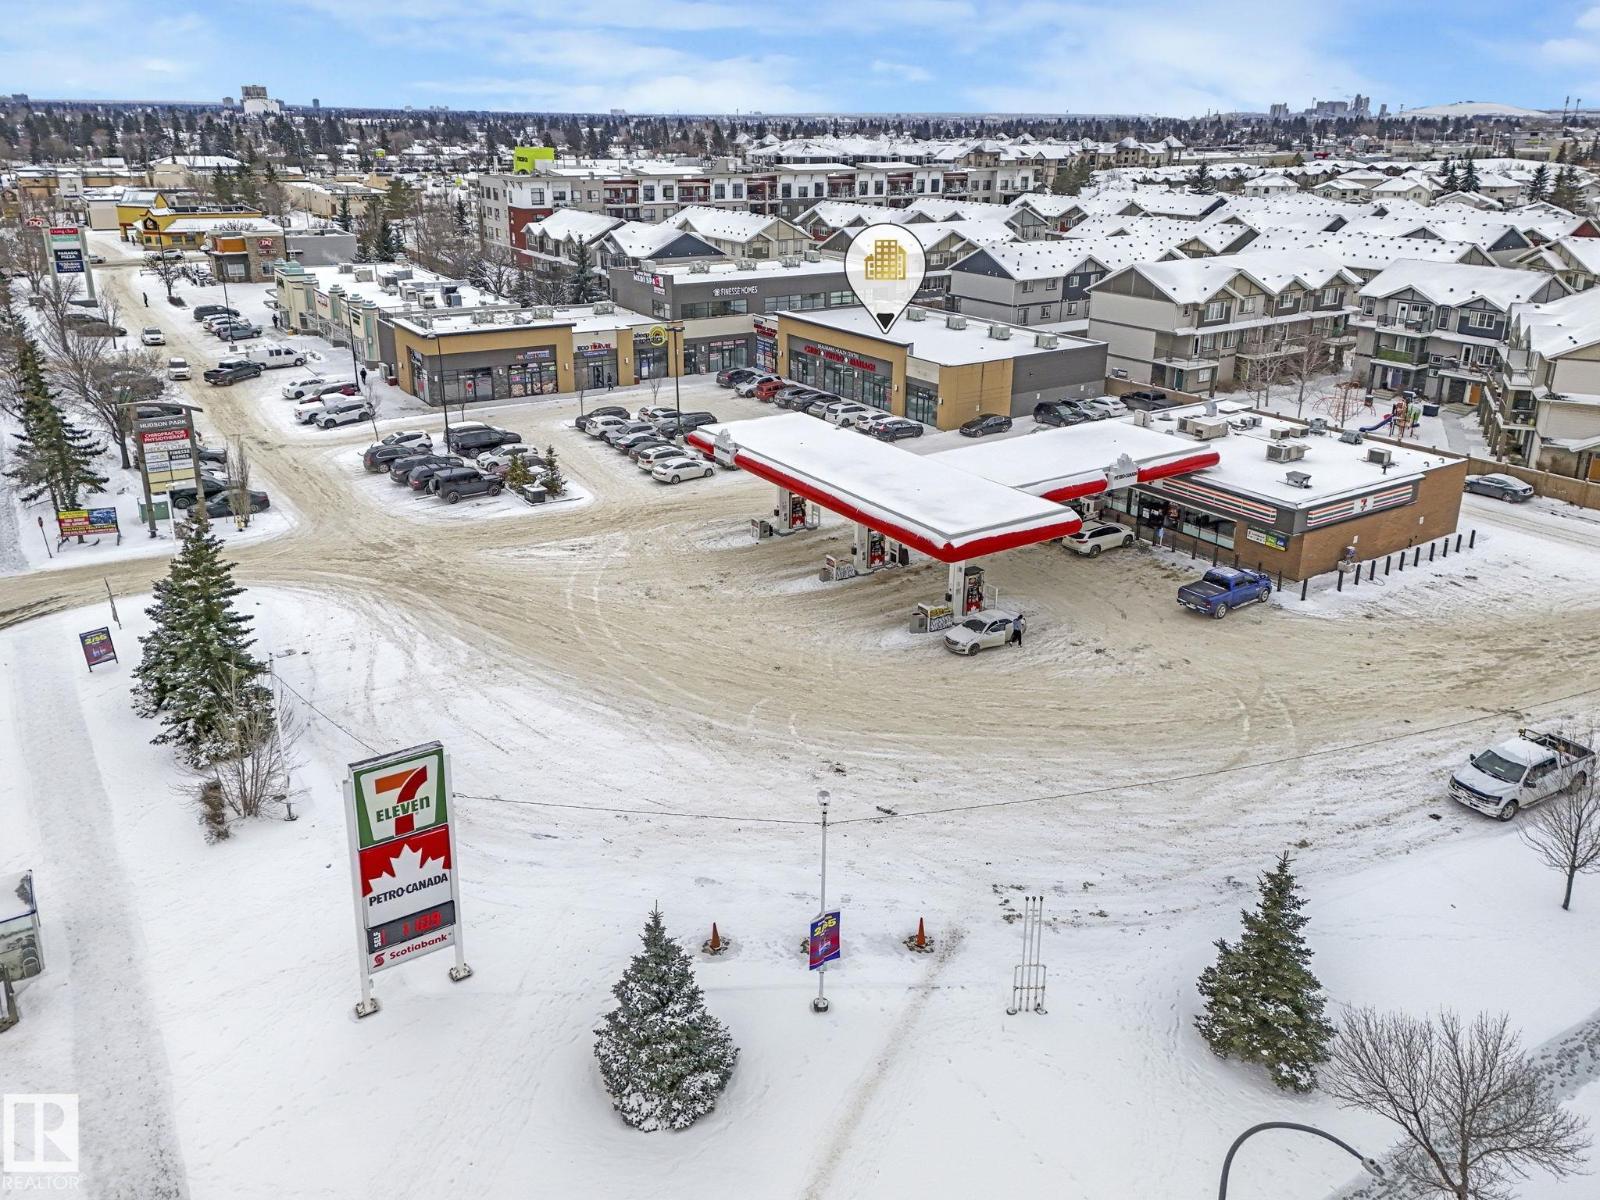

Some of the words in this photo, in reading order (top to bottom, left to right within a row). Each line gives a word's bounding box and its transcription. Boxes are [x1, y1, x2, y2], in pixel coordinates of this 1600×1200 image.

[720, 287, 740, 296] FINESSE
[741, 286, 758, 294] HOMES
[144, 434, 187, 442] PHYSIOTHERAPY
[374, 764, 428, 836] 7
[368, 873, 449, 906] PETRO-CANADA
[389, 933, 448, 960] Scotiabank
